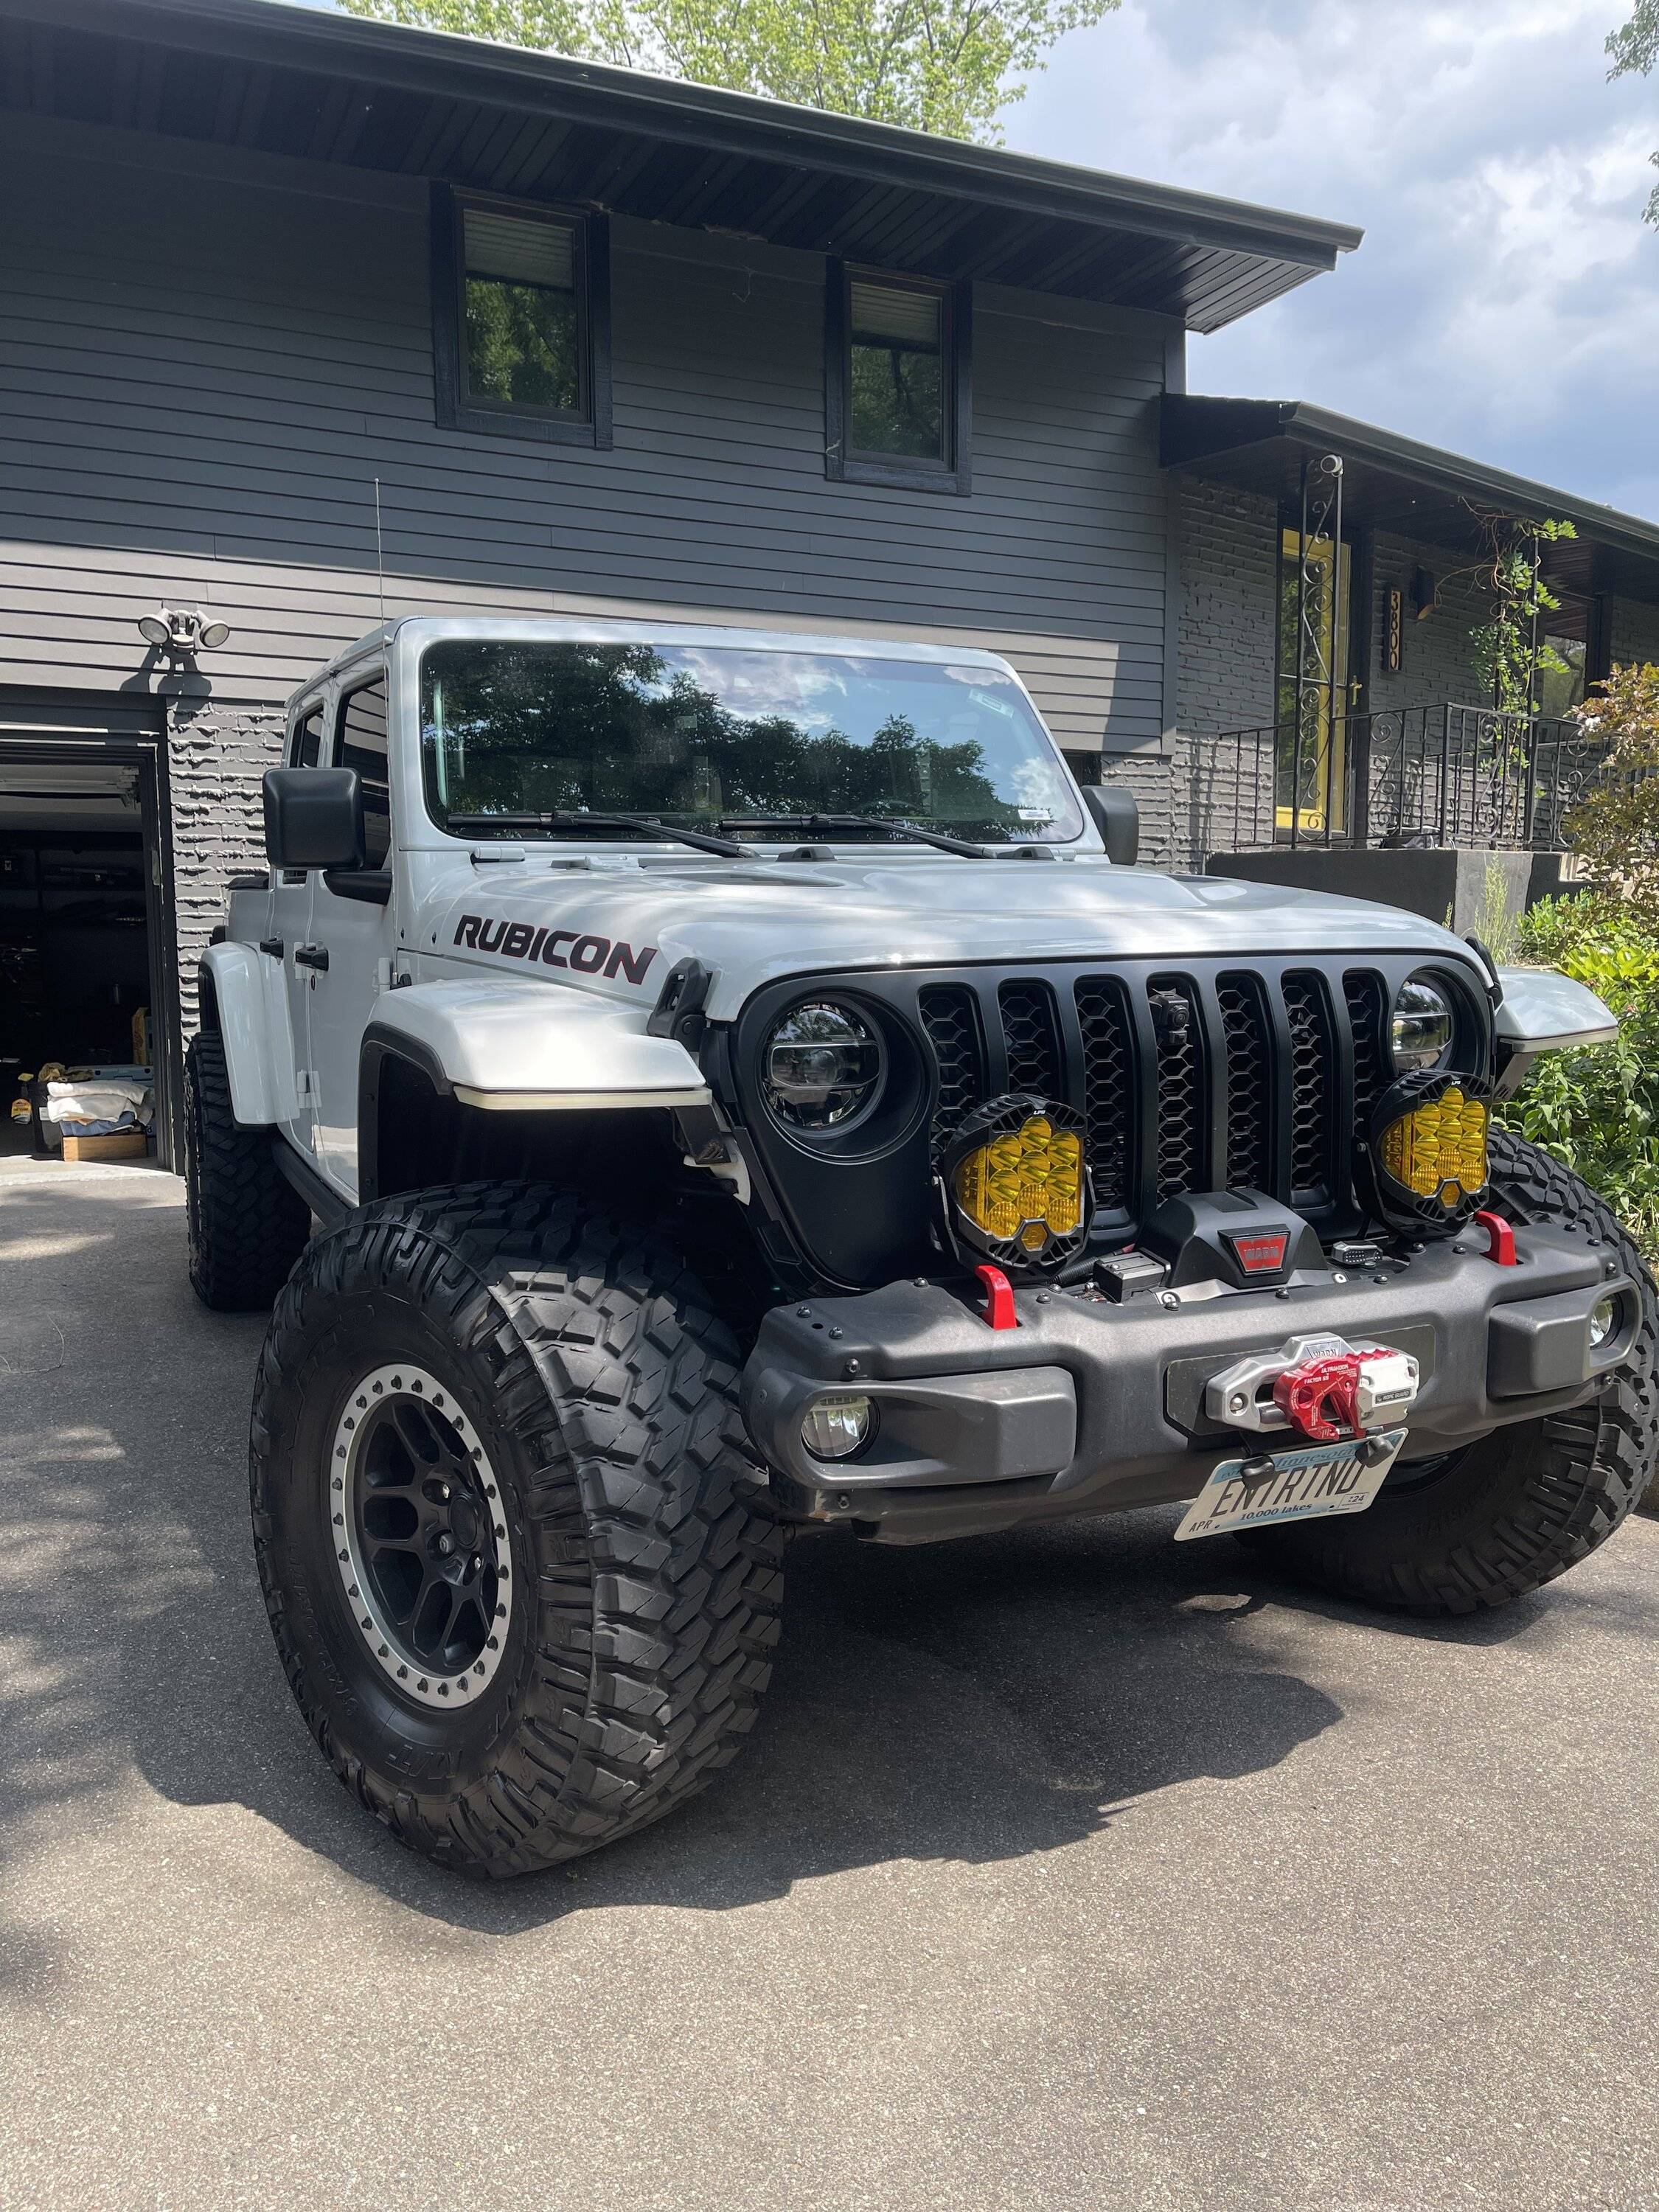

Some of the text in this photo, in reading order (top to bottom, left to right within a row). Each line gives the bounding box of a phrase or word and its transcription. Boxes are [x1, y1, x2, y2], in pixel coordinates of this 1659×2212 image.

[1390, 592, 1399, 669] 3800
[453, 914, 658, 985] RUBICON
[1243, 1246, 1281, 1261] WARN
[1276, 1447, 1354, 1467] innesota
[1352, 1495, 1365, 1509] 24
[1239, 1503, 1312, 1521] 10,000 lakes
[1189, 1520, 1213, 1533] APR
